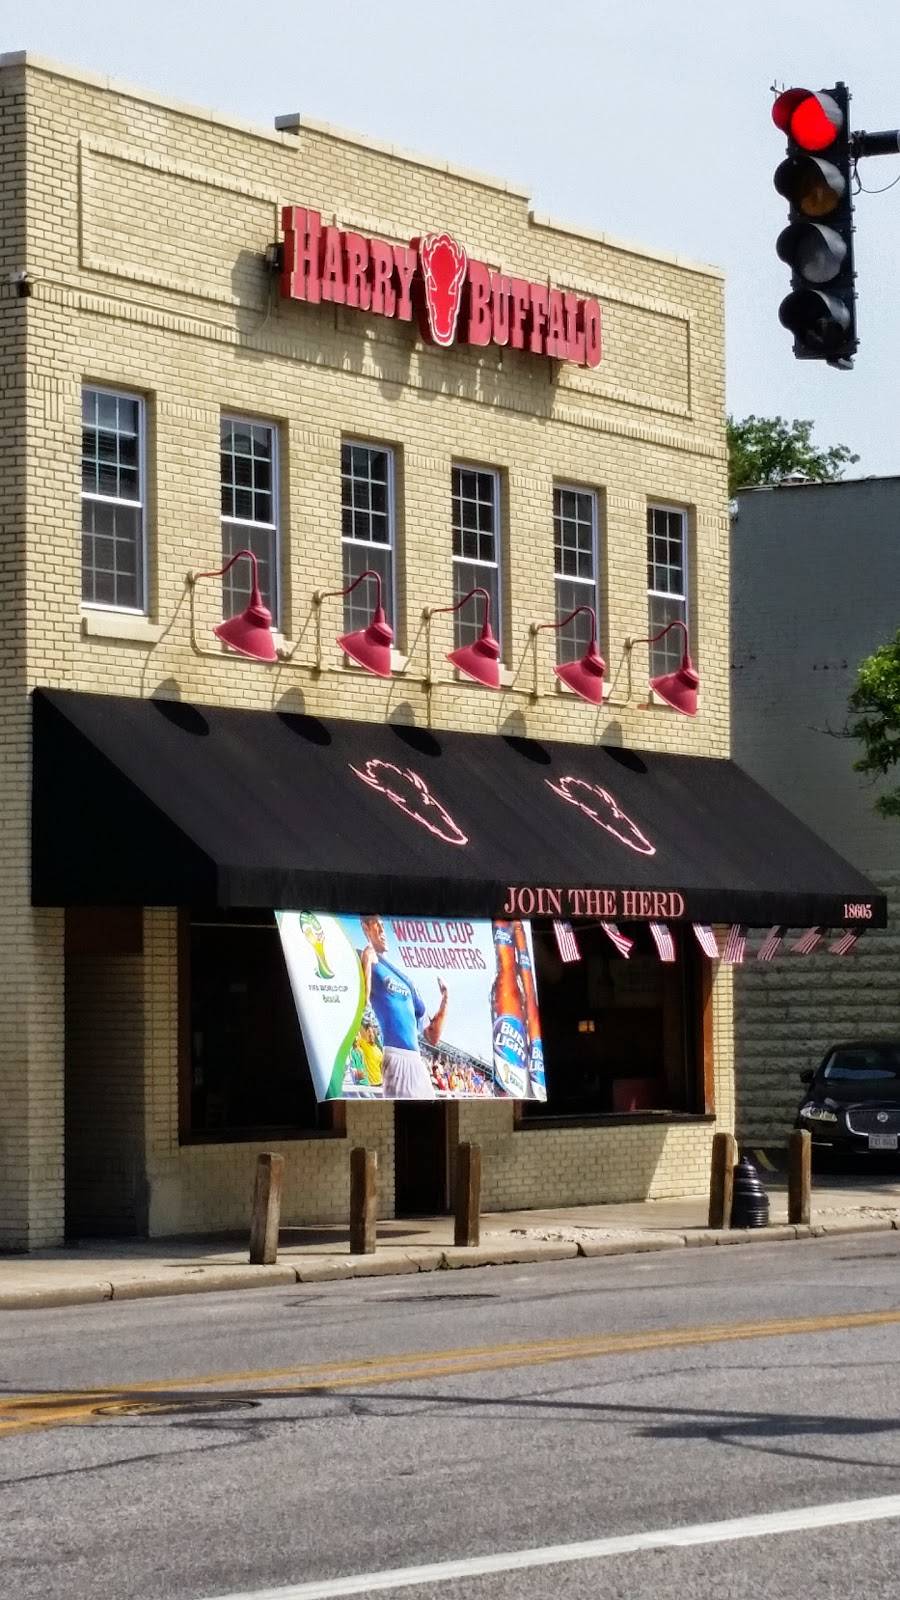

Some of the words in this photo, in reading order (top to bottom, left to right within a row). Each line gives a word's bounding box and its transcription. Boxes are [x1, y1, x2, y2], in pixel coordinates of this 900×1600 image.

[282, 206, 417, 321] HARRY
[468, 259, 602, 368] BUFFALO
[504, 887, 563, 915] JOIN
[568, 889, 617, 916] THE
[621, 890, 685, 917] HERD
[844, 903, 873, 919] 18605
[392, 919, 446, 943] WORLD
[446, 921, 475, 944] CUP
[399, 946, 487, 970] HEADQUARTERS
